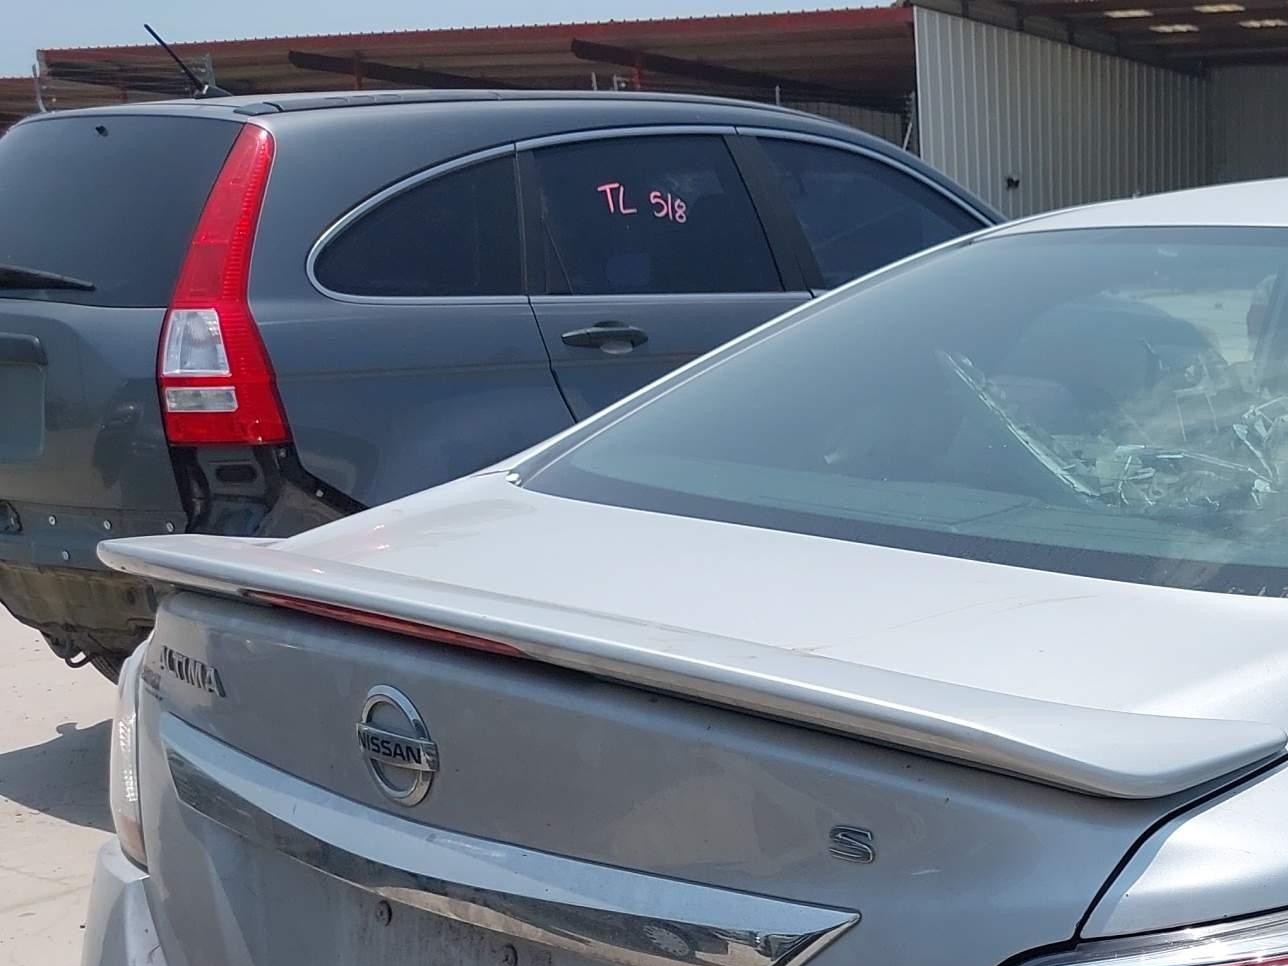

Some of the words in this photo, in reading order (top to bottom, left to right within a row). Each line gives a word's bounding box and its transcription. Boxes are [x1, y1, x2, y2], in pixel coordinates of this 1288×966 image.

[597, 182, 637, 214] TL
[160, 645, 226, 698] ALTIMA
[358, 729, 422, 765] NISSAN
[828, 825, 876, 864] S
